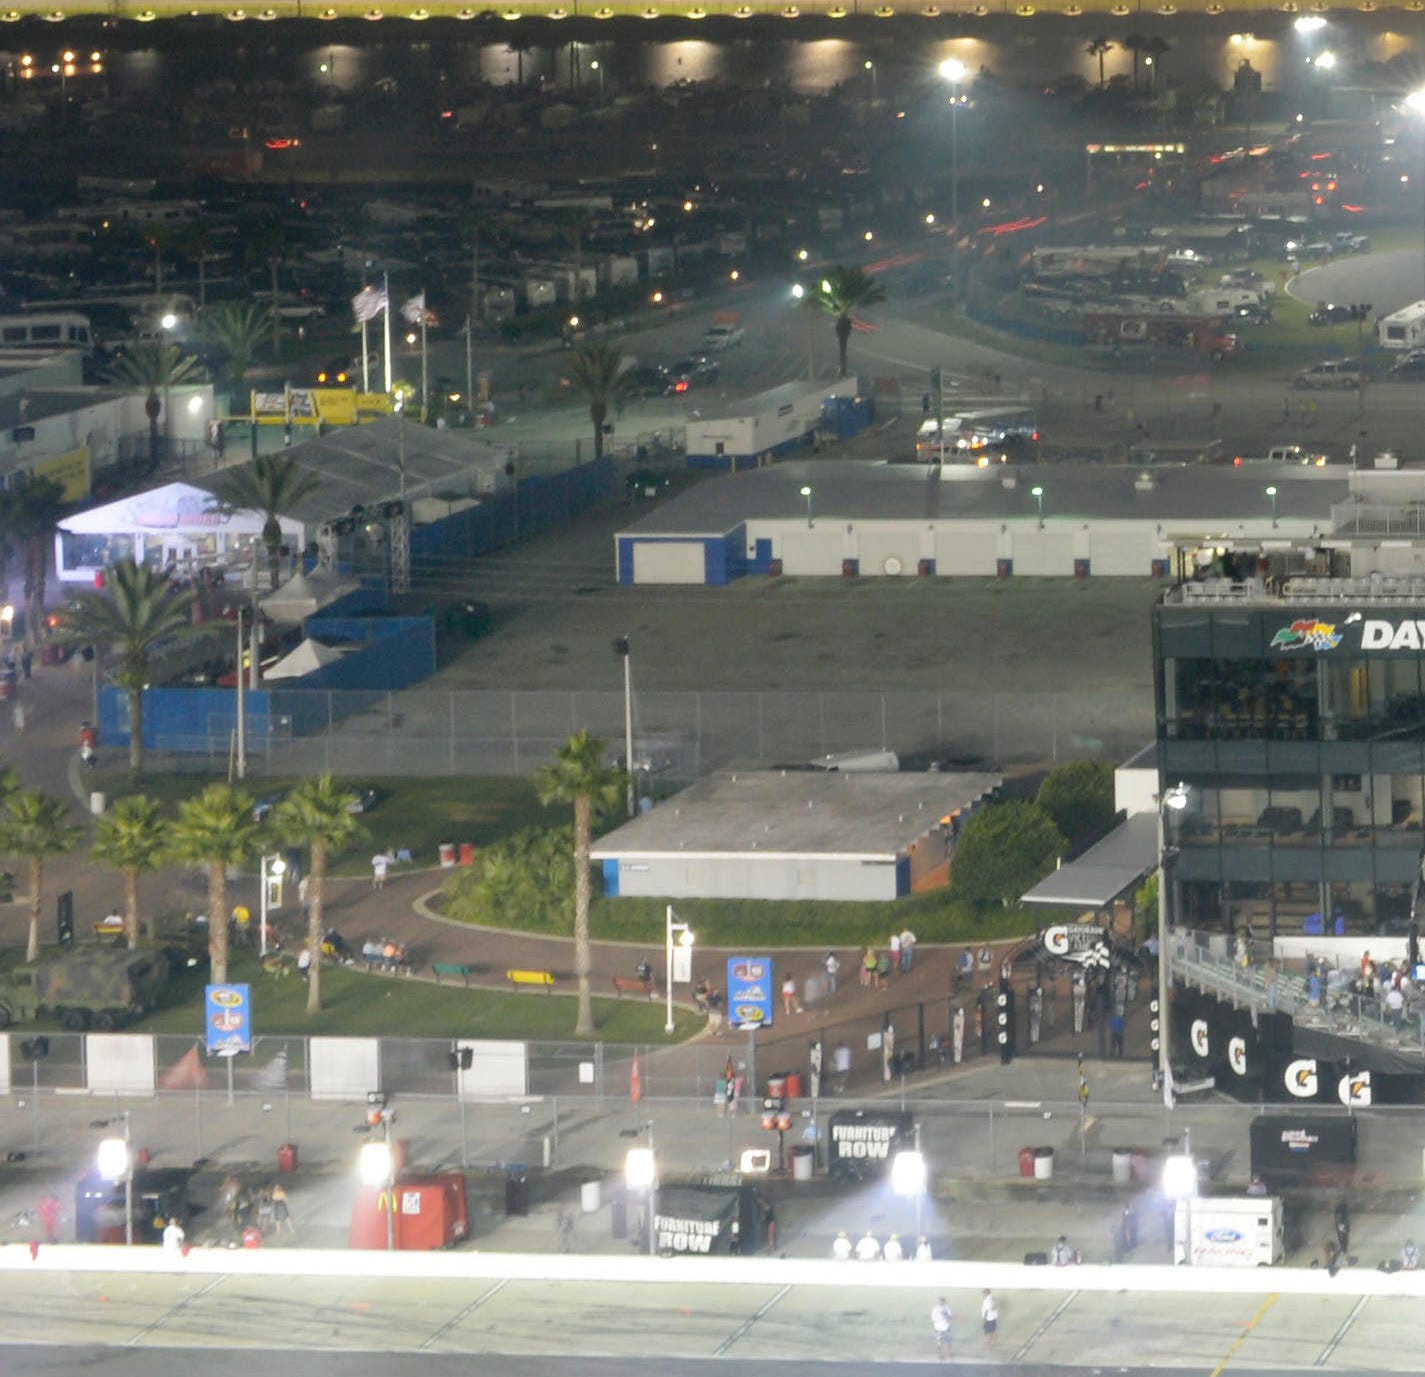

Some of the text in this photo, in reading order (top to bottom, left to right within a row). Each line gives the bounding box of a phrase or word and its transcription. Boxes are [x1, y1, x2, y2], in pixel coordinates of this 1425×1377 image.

[839, 1141, 889, 1158] ROW
[654, 1215, 719, 1236] FURNITURE
[659, 1231, 712, 1253] ROW
